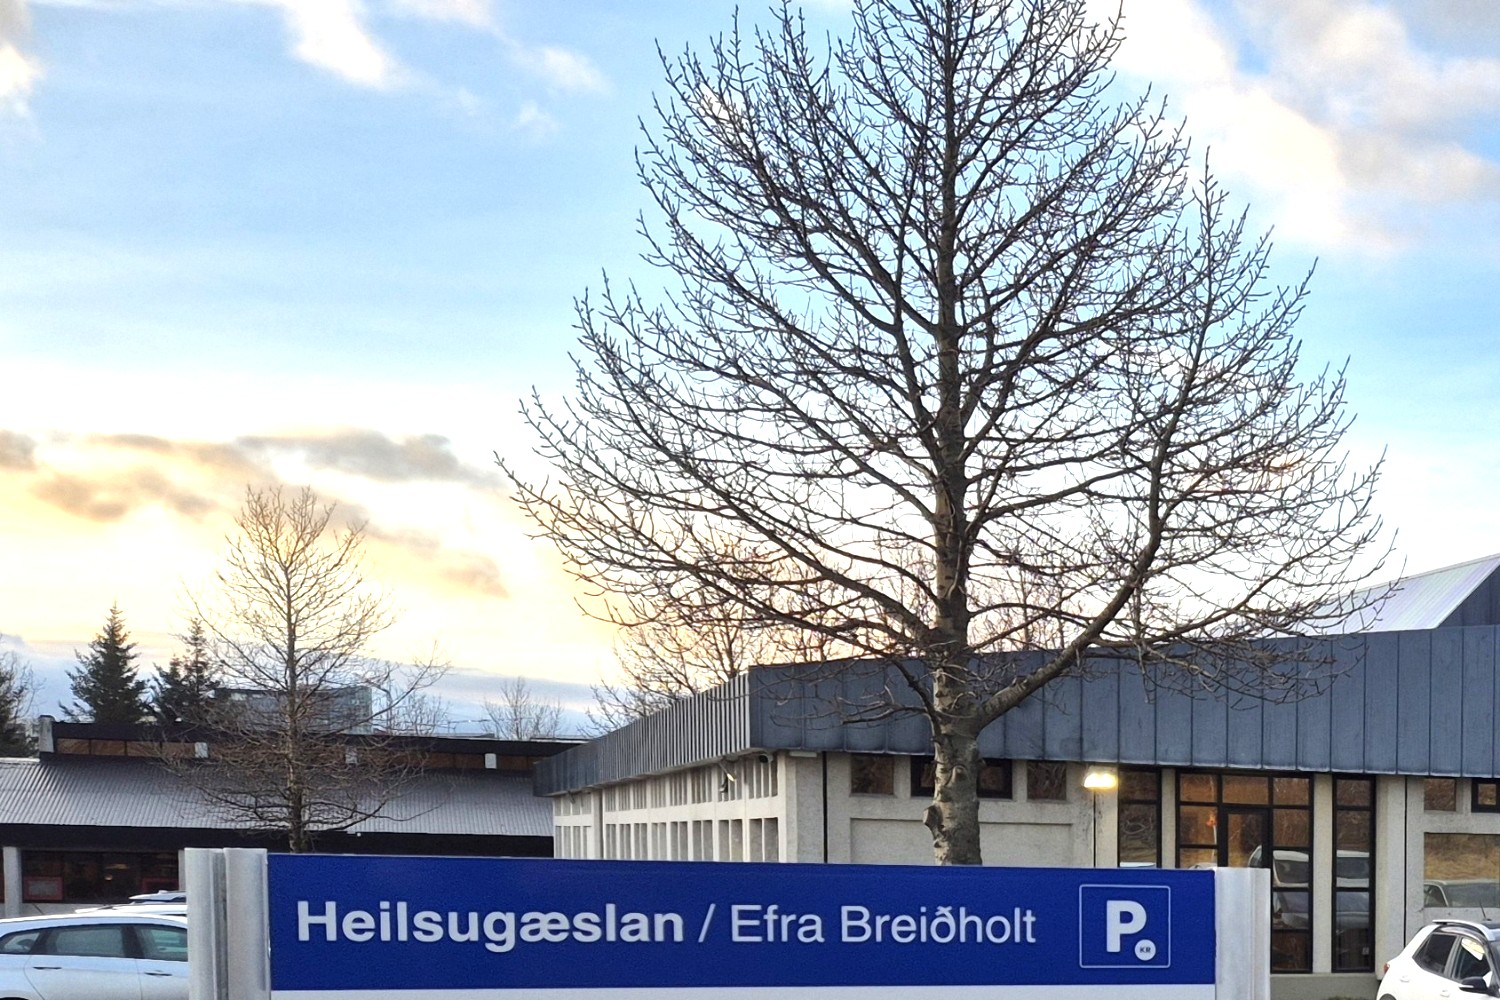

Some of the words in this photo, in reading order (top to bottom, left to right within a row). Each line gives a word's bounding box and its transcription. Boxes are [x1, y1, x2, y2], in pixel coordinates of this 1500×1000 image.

[297, 900, 683, 953] Heilsugæslan
[698, 903, 715, 943] /
[732, 905, 824, 944] Efra
[840, 905, 1036, 944] Breiðholt
[1106, 900, 1147, 952] P
